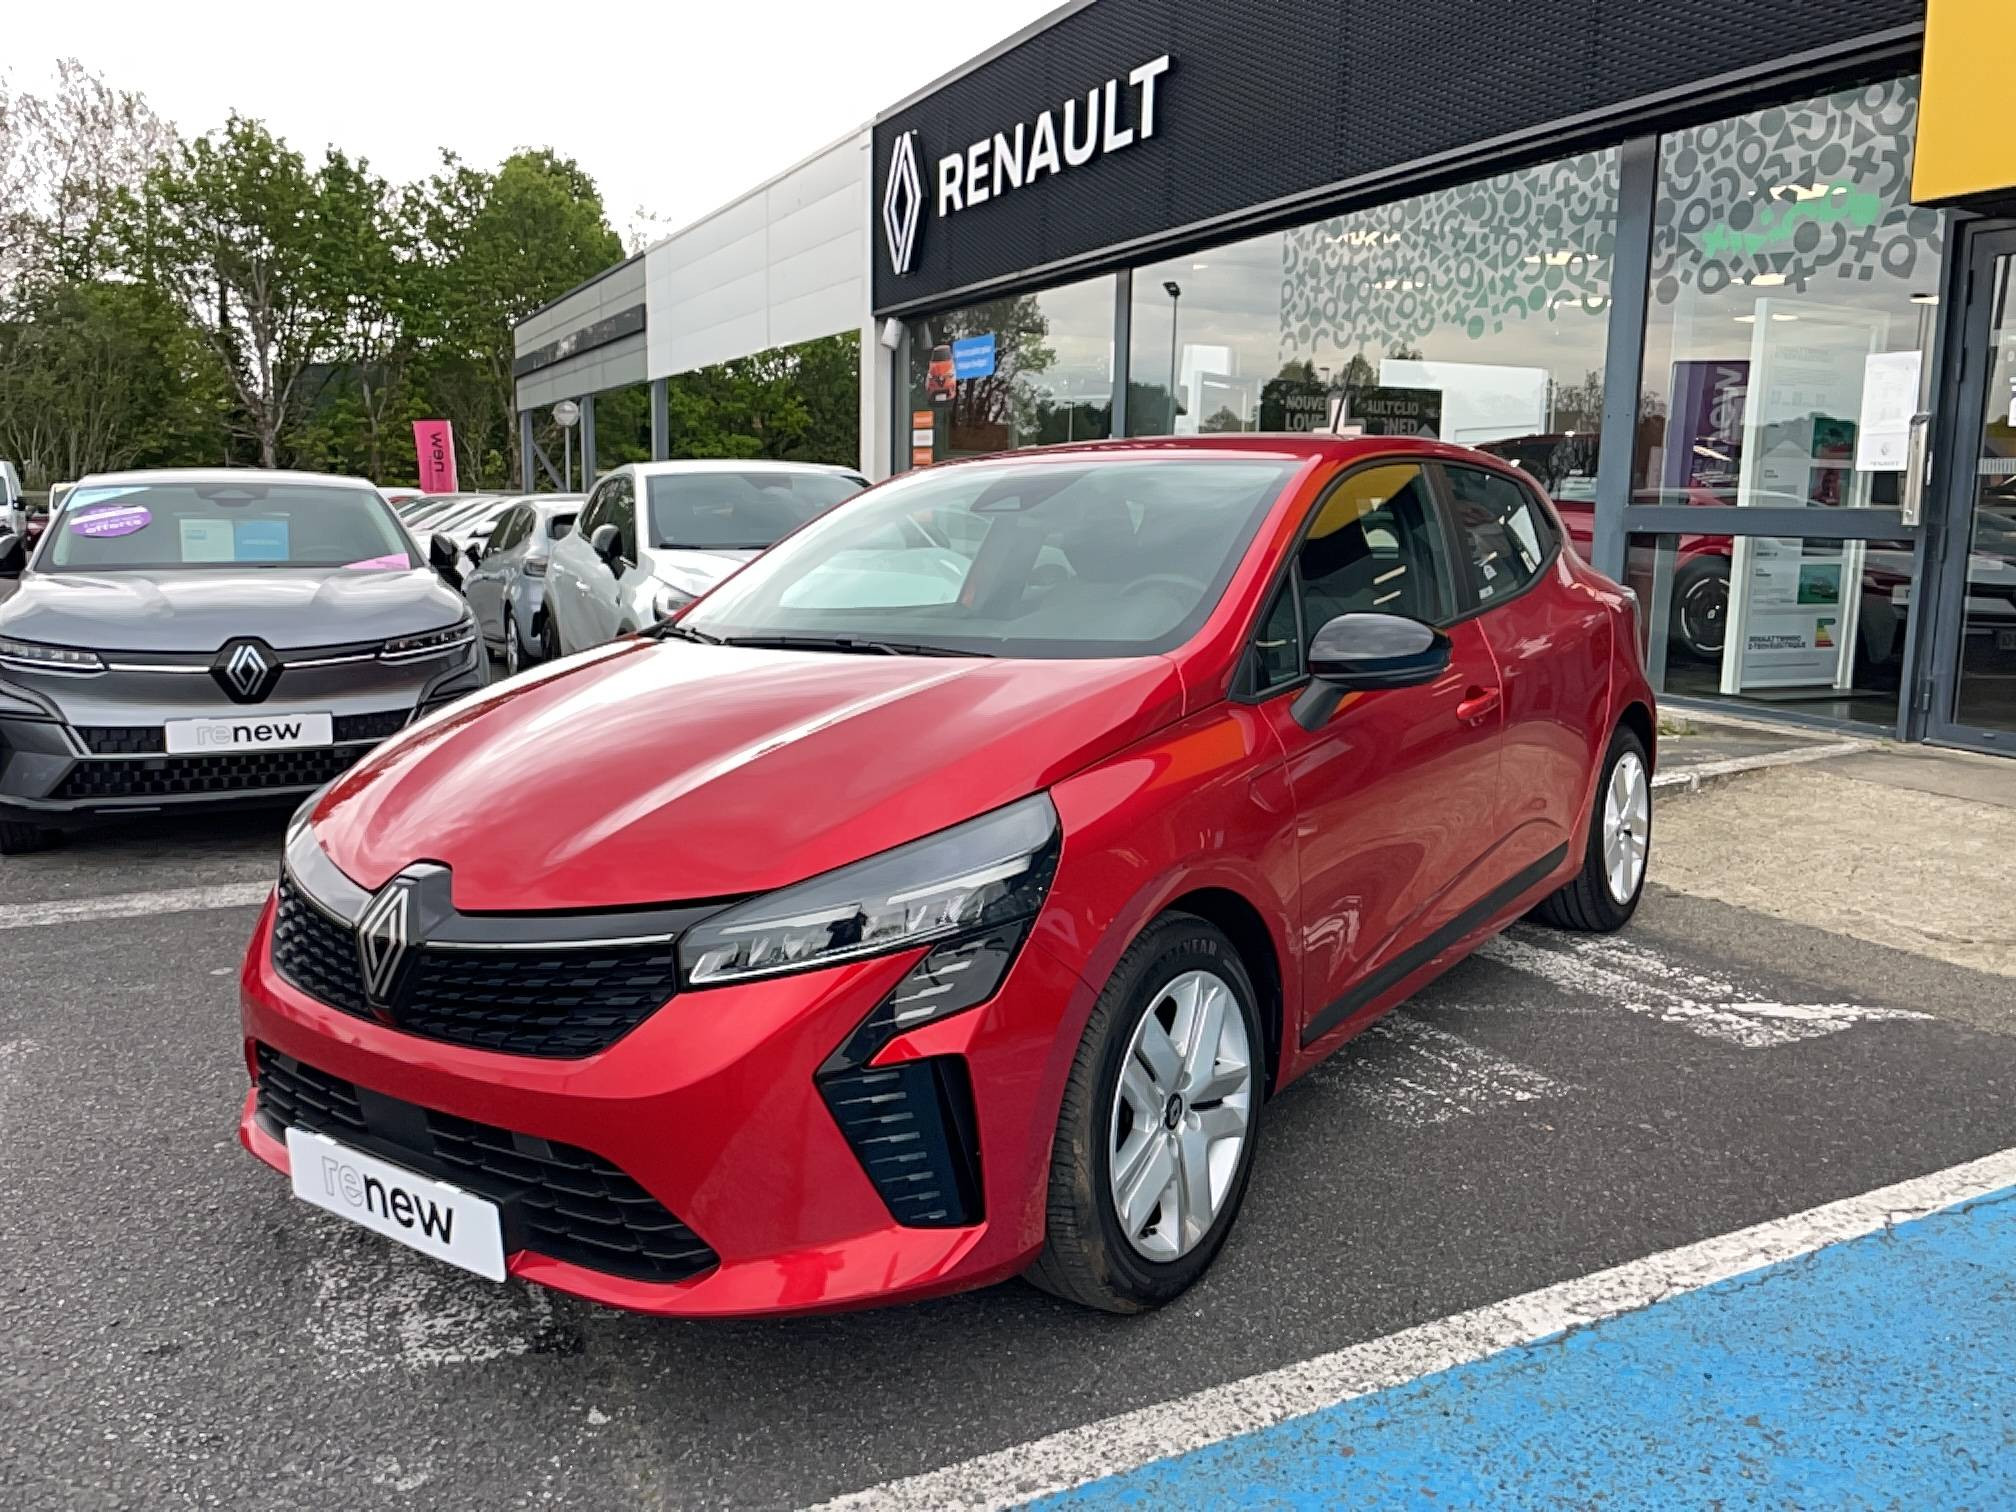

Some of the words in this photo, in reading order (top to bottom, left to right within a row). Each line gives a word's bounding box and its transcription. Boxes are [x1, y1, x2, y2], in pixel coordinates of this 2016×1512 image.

[938, 55, 1170, 218] RENAULT
[196, 722, 302, 746] renew
[321, 1156, 455, 1245] renew
